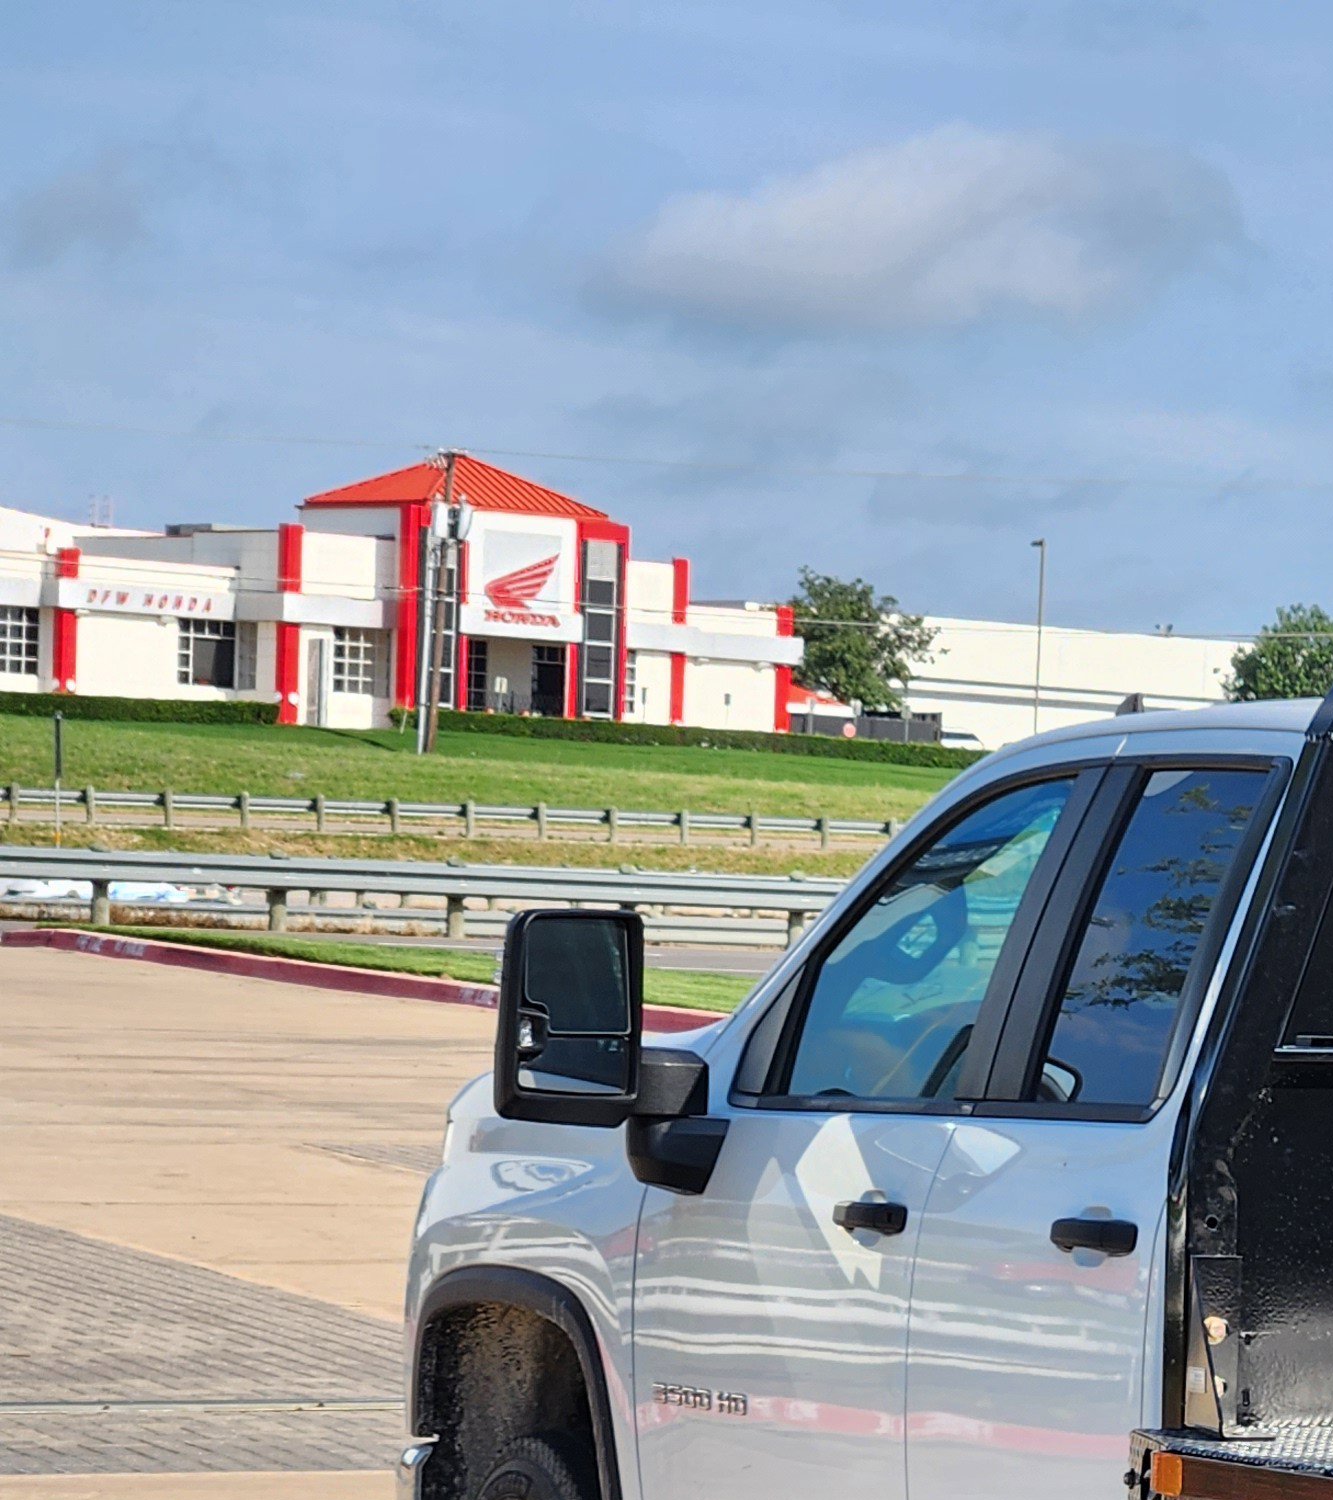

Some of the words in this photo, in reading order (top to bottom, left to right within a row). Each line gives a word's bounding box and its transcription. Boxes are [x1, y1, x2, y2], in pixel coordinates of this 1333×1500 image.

[87, 588, 130, 604] DFW
[143, 593, 213, 613] HONDA
[484, 609, 561, 628] HONDA
[652, 1381, 711, 1411] 3500
[716, 1391, 748, 1416] HD
